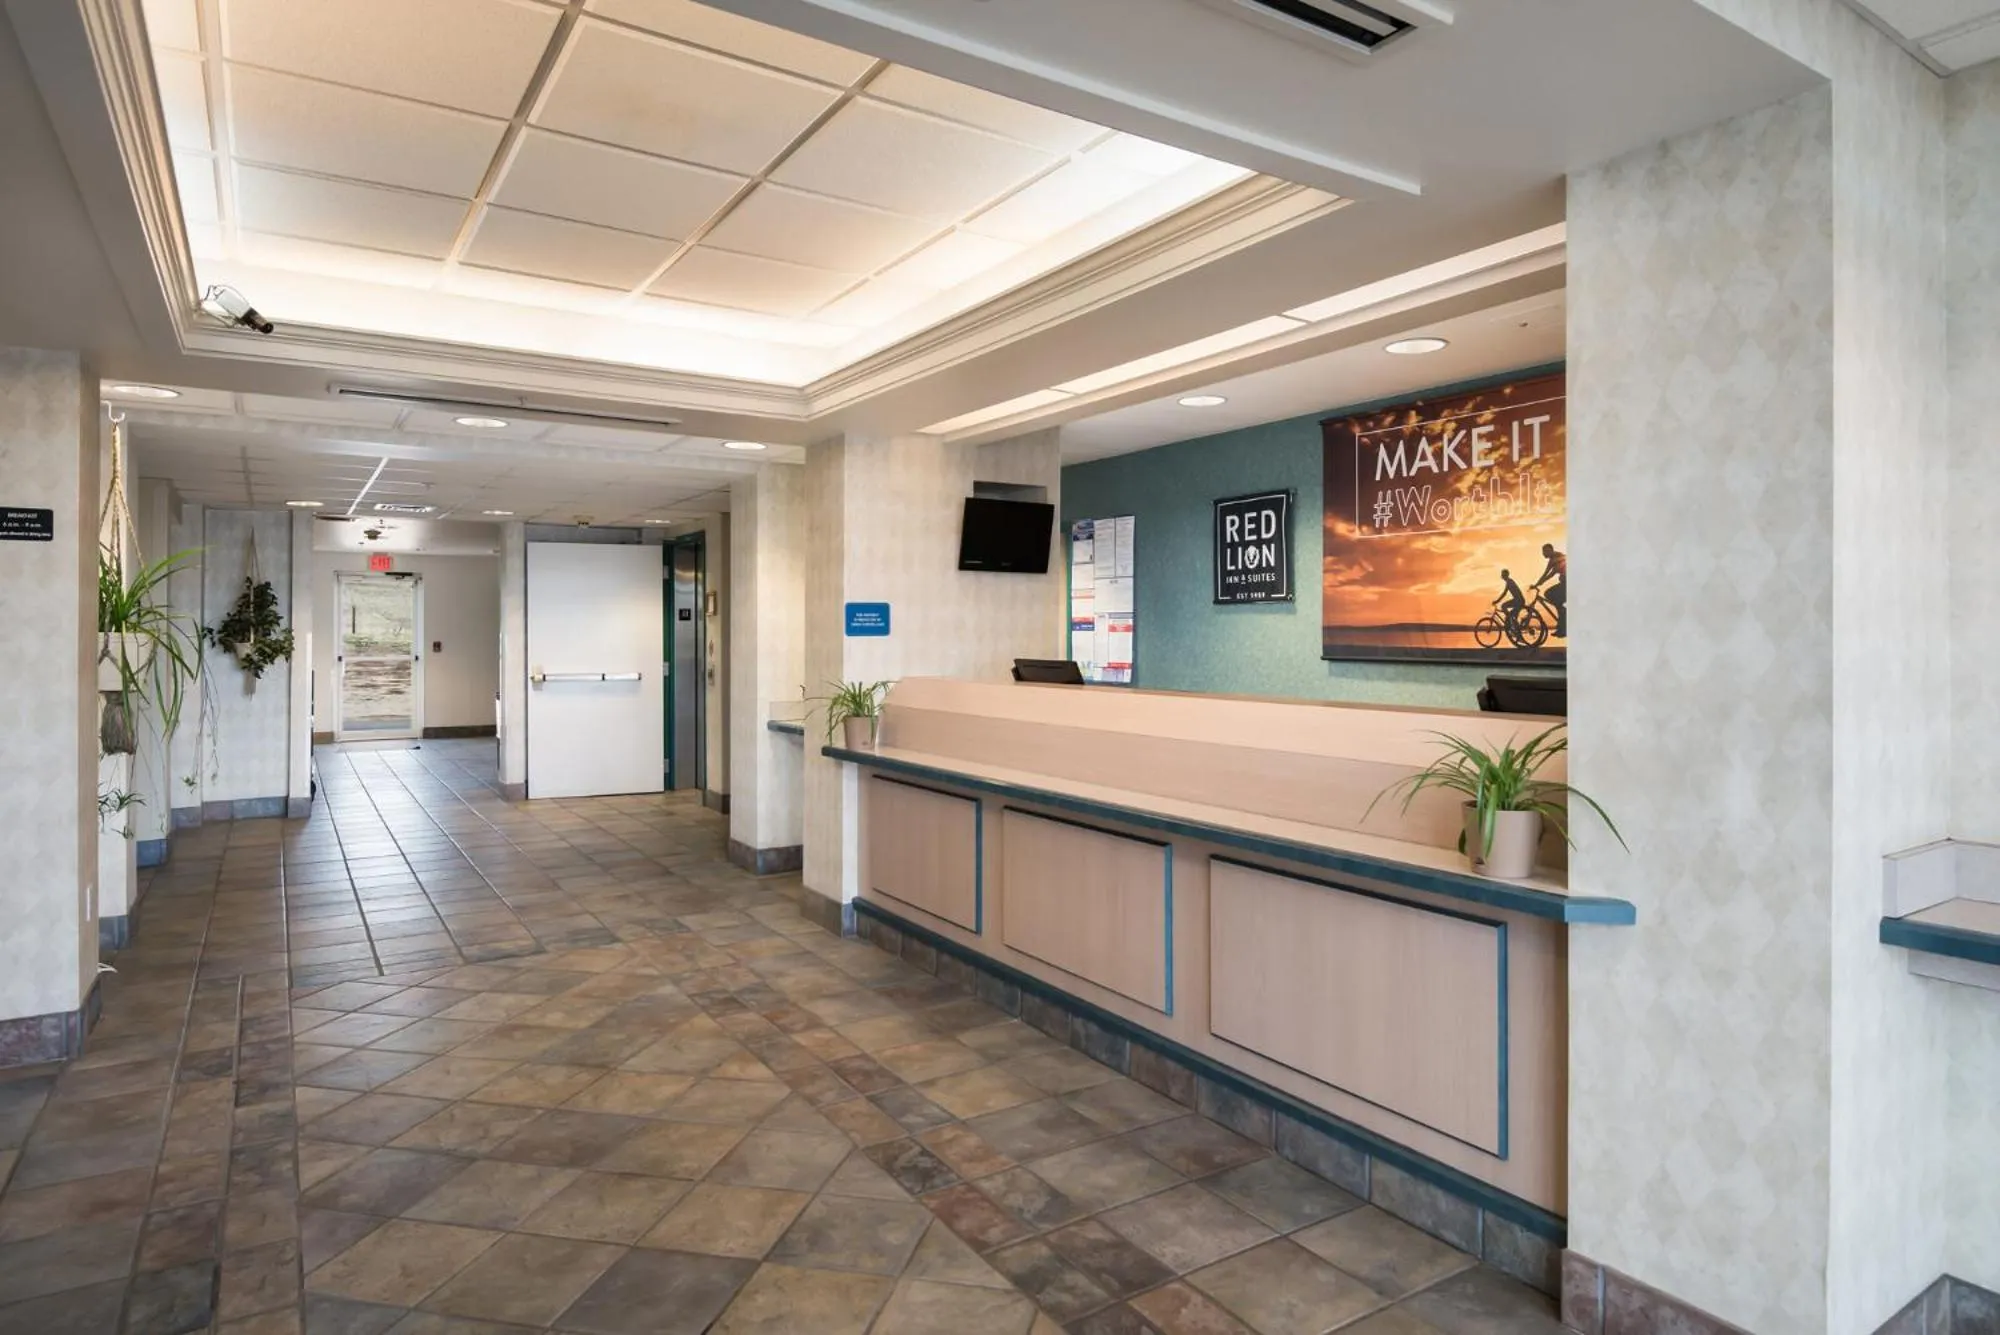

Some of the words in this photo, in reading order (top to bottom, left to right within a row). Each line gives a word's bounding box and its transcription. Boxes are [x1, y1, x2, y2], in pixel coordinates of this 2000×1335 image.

[1375, 424, 1495, 481] MAKE
[1512, 414, 1551, 463] IT
[1373, 473, 1552, 529] #WorthIt
[1225, 509, 1277, 543] RED
[1226, 543, 1276, 571] LION
[1226, 576, 1240, 584] INN
[1247, 572, 1276, 582] SUITES
